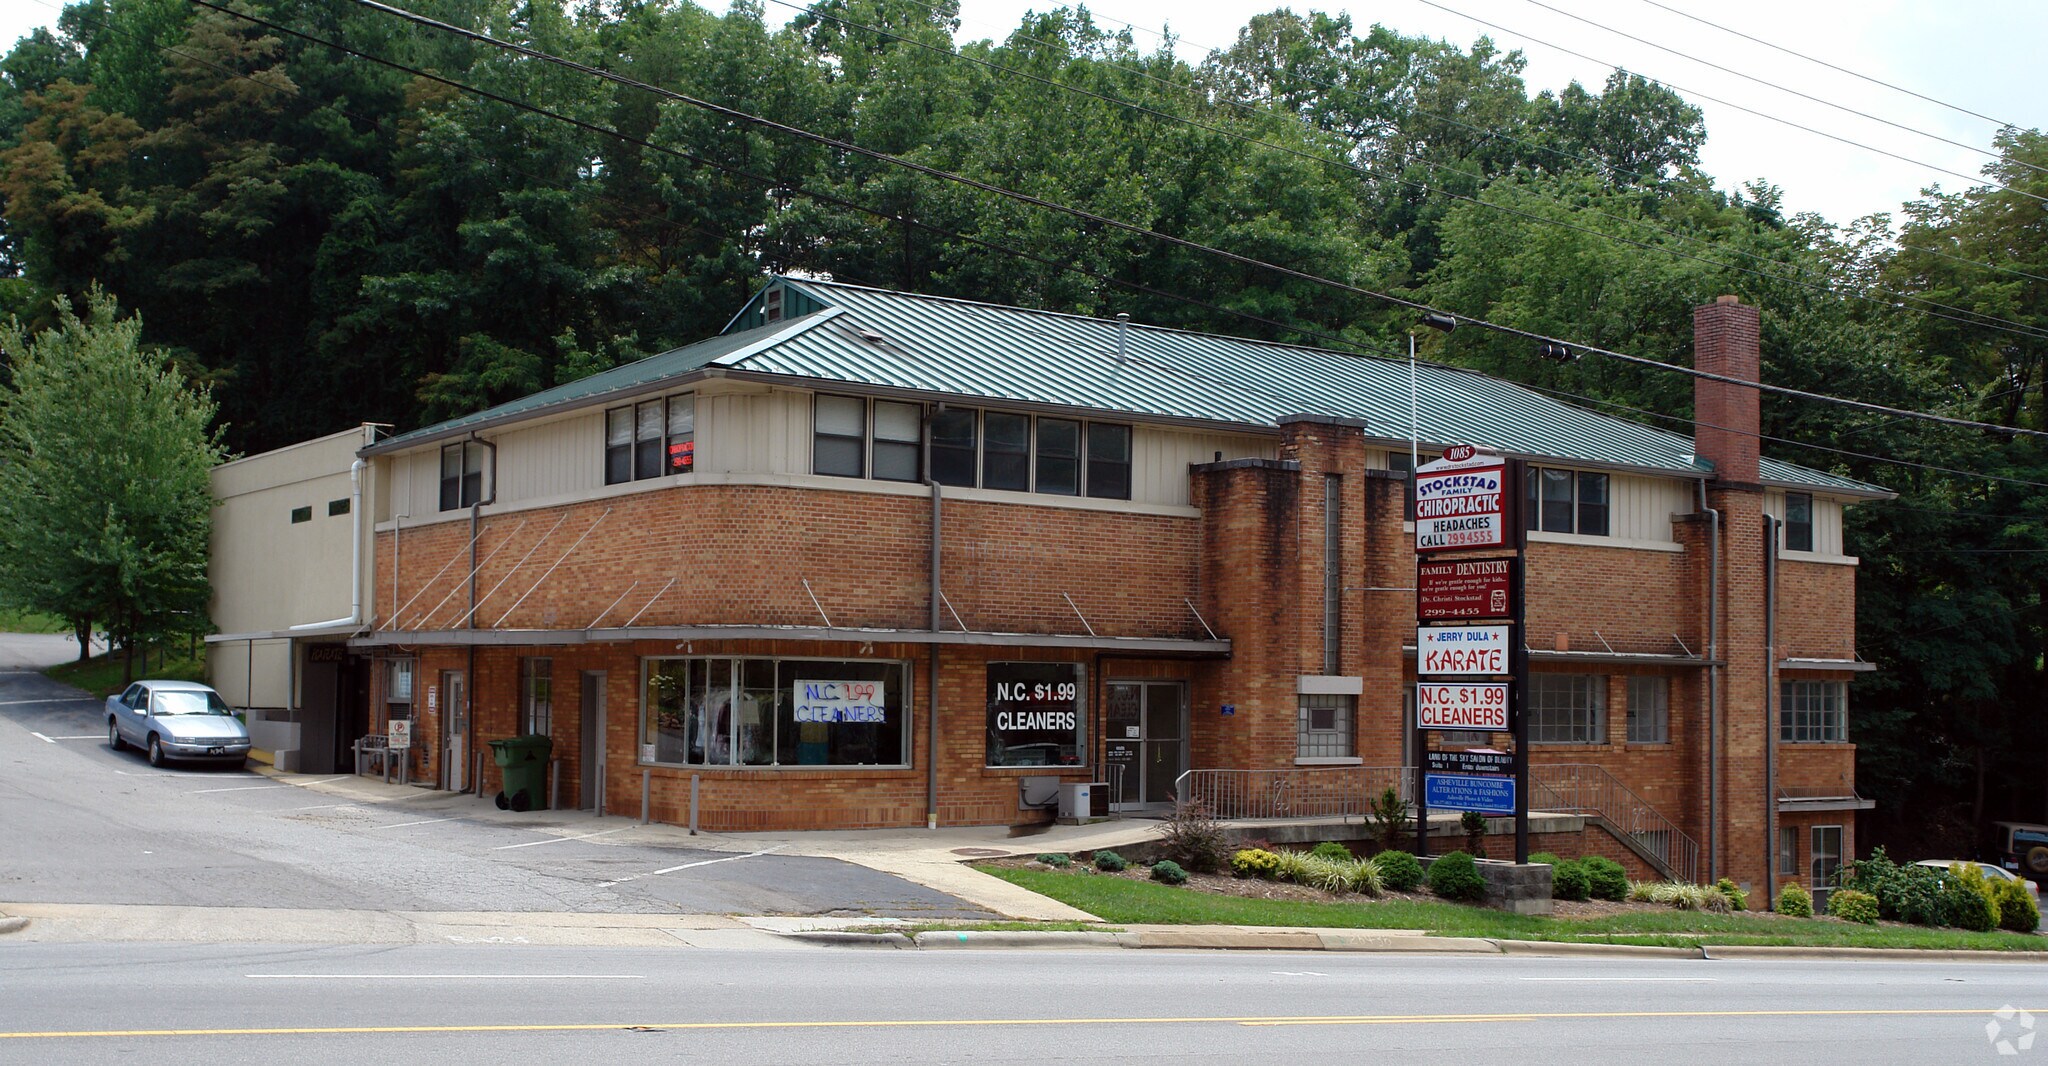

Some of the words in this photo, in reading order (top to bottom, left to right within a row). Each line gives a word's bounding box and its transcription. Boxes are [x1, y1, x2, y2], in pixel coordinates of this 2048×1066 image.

[1449, 446, 1470, 460] 1085
[1419, 476, 1497, 496] STOCKSTAD
[1442, 488, 1473, 496] FAMILY
[1417, 494, 1499, 518] CHIROPRACTIC
[1433, 517, 1490, 533] HEADACHES
[1420, 534, 1446, 547] CALL
[1448, 531, 1493, 545] 2994555
[1420, 565, 1454, 576] FAMILY
[1456, 560, 1509, 576] DENTISTRY
[1464, 577, 1482, 585] enough
[1424, 607, 1479, 616] 299-4455
[1437, 632, 1463, 642] JERRY
[1466, 632, 1489, 641] DULA
[1425, 648, 1502, 672] KARATE
[997, 682, 1030, 701] N.C.
[1034, 682, 1076, 701] $1.99
[1421, 687, 1454, 705] N.C.
[1459, 687, 1504, 705] $1.99
[997, 712, 1076, 731] CLEANERS
[1421, 707, 1504, 726] CLEANERS
[1432, 786, 1473, 795] ALTERATIONS
[1479, 789, 1509, 797] FASHIONS
[1436, 779, 1469, 788] ASHEVILLE
[1470, 780, 1504, 789] BUNCOMBE
